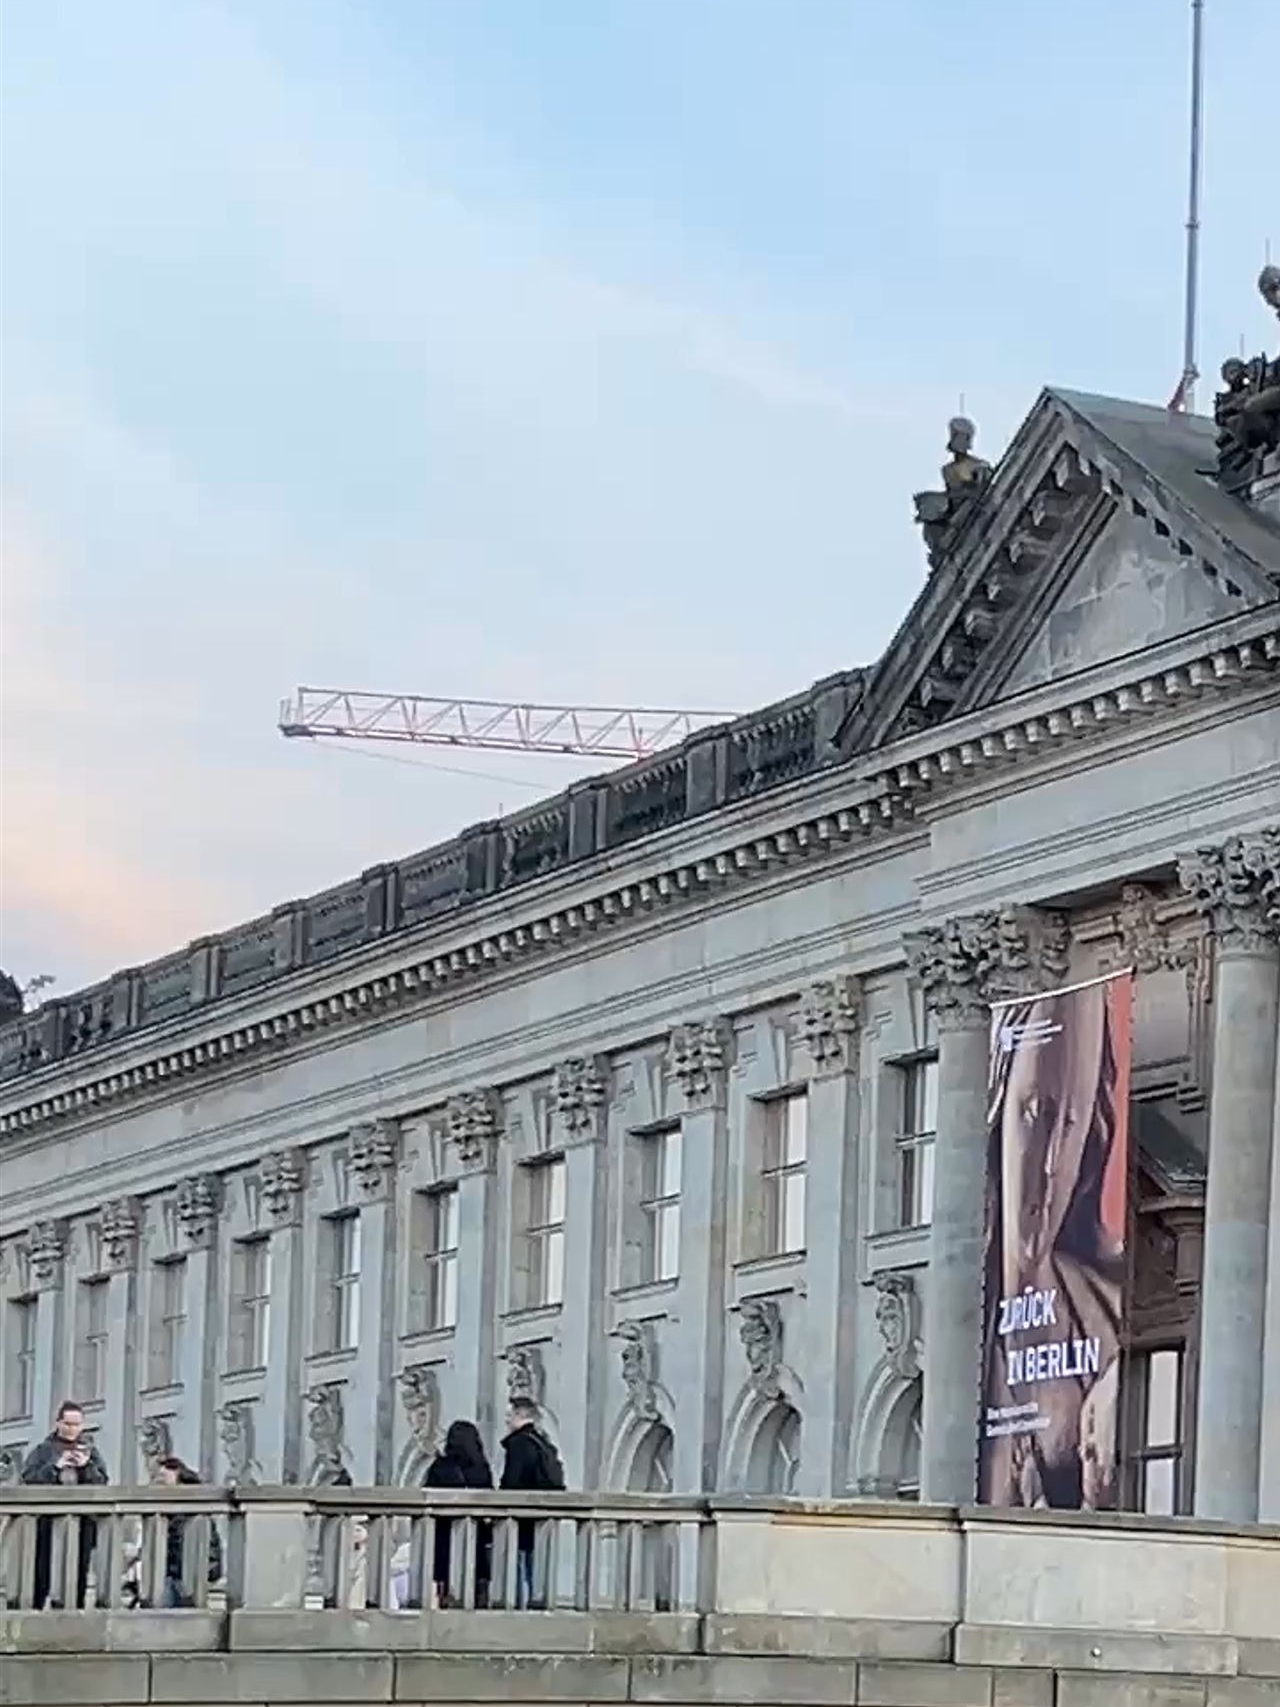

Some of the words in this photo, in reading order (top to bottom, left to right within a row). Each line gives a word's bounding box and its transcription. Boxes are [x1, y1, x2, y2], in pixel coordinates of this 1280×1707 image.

[998, 1285, 1057, 1335] ZURÜCK
[1006, 1350, 1024, 1385] IN
[1025, 1337, 1100, 1383] BERLIN
